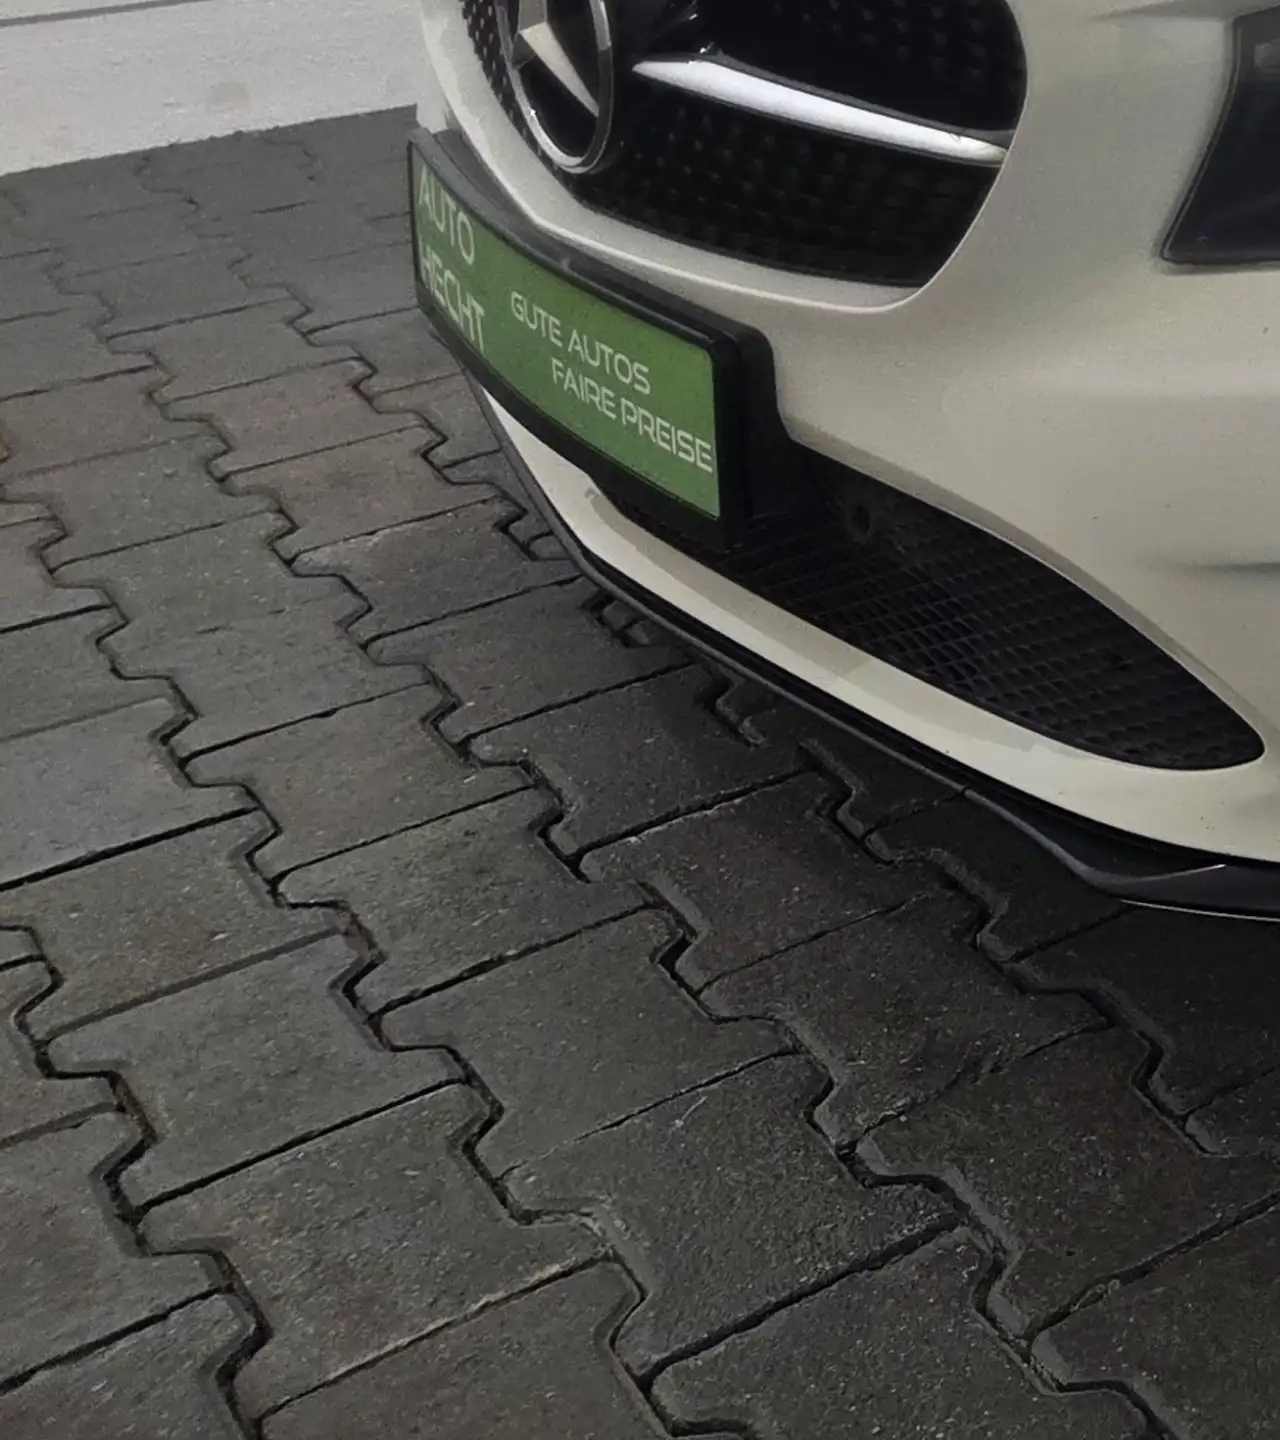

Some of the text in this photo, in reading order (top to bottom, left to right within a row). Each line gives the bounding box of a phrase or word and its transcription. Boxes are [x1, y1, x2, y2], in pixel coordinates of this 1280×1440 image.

[418, 164, 475, 265] AUTO
[418, 235, 485, 354] HECHT
[511, 291, 651, 395] GUTE AUTOS
[551, 356, 713, 474] FAIRE PREISE
